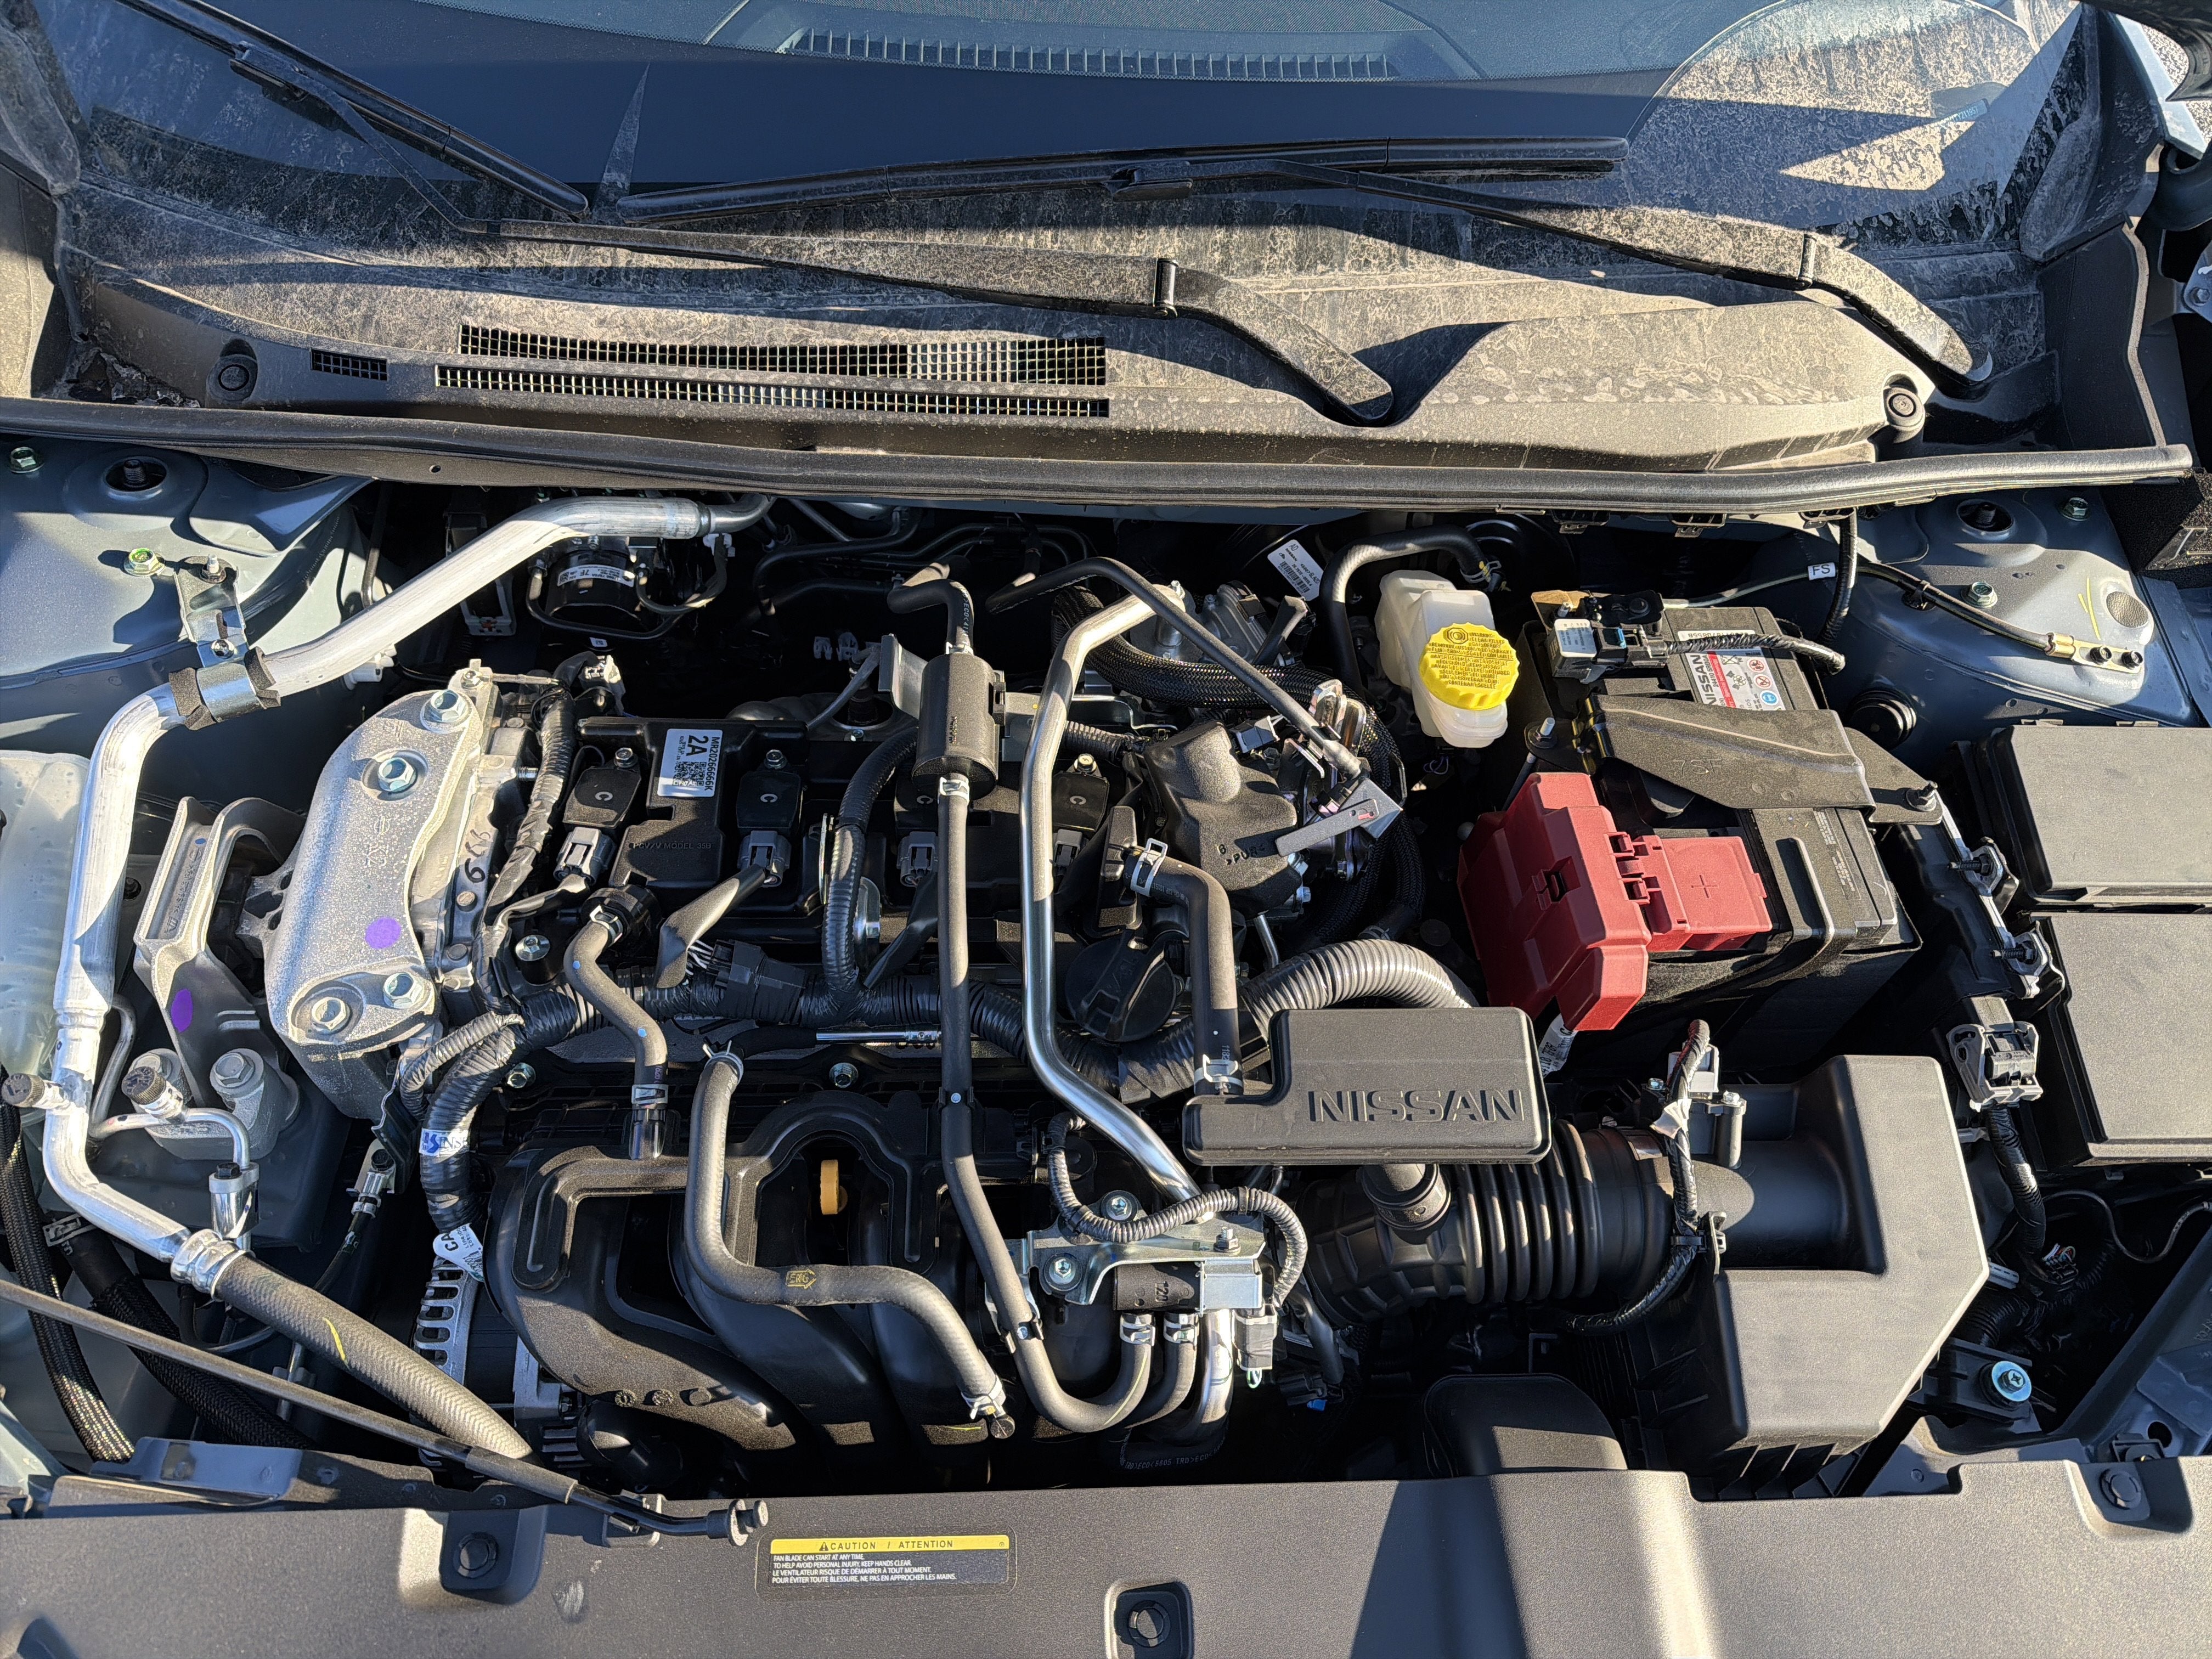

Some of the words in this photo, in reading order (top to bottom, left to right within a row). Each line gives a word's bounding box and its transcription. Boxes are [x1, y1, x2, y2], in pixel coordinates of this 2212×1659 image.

[1812, 564, 1831, 575] FS
[1690, 654, 1717, 705] NISSAN
[686, 735, 709, 756] 2A
[704, 737, 720, 791] MR20266666K
[1672, 758, 1722, 776] 7SF
[1309, 1089, 1525, 1122] NISSAN
[441, 1233, 459, 1251] CA
[789, 1273, 809, 1284] ENG
[830, 1542, 876, 1550] CAUTION
[887, 1541, 891, 1549] /
[898, 1540, 953, 1549] ATTENTION
